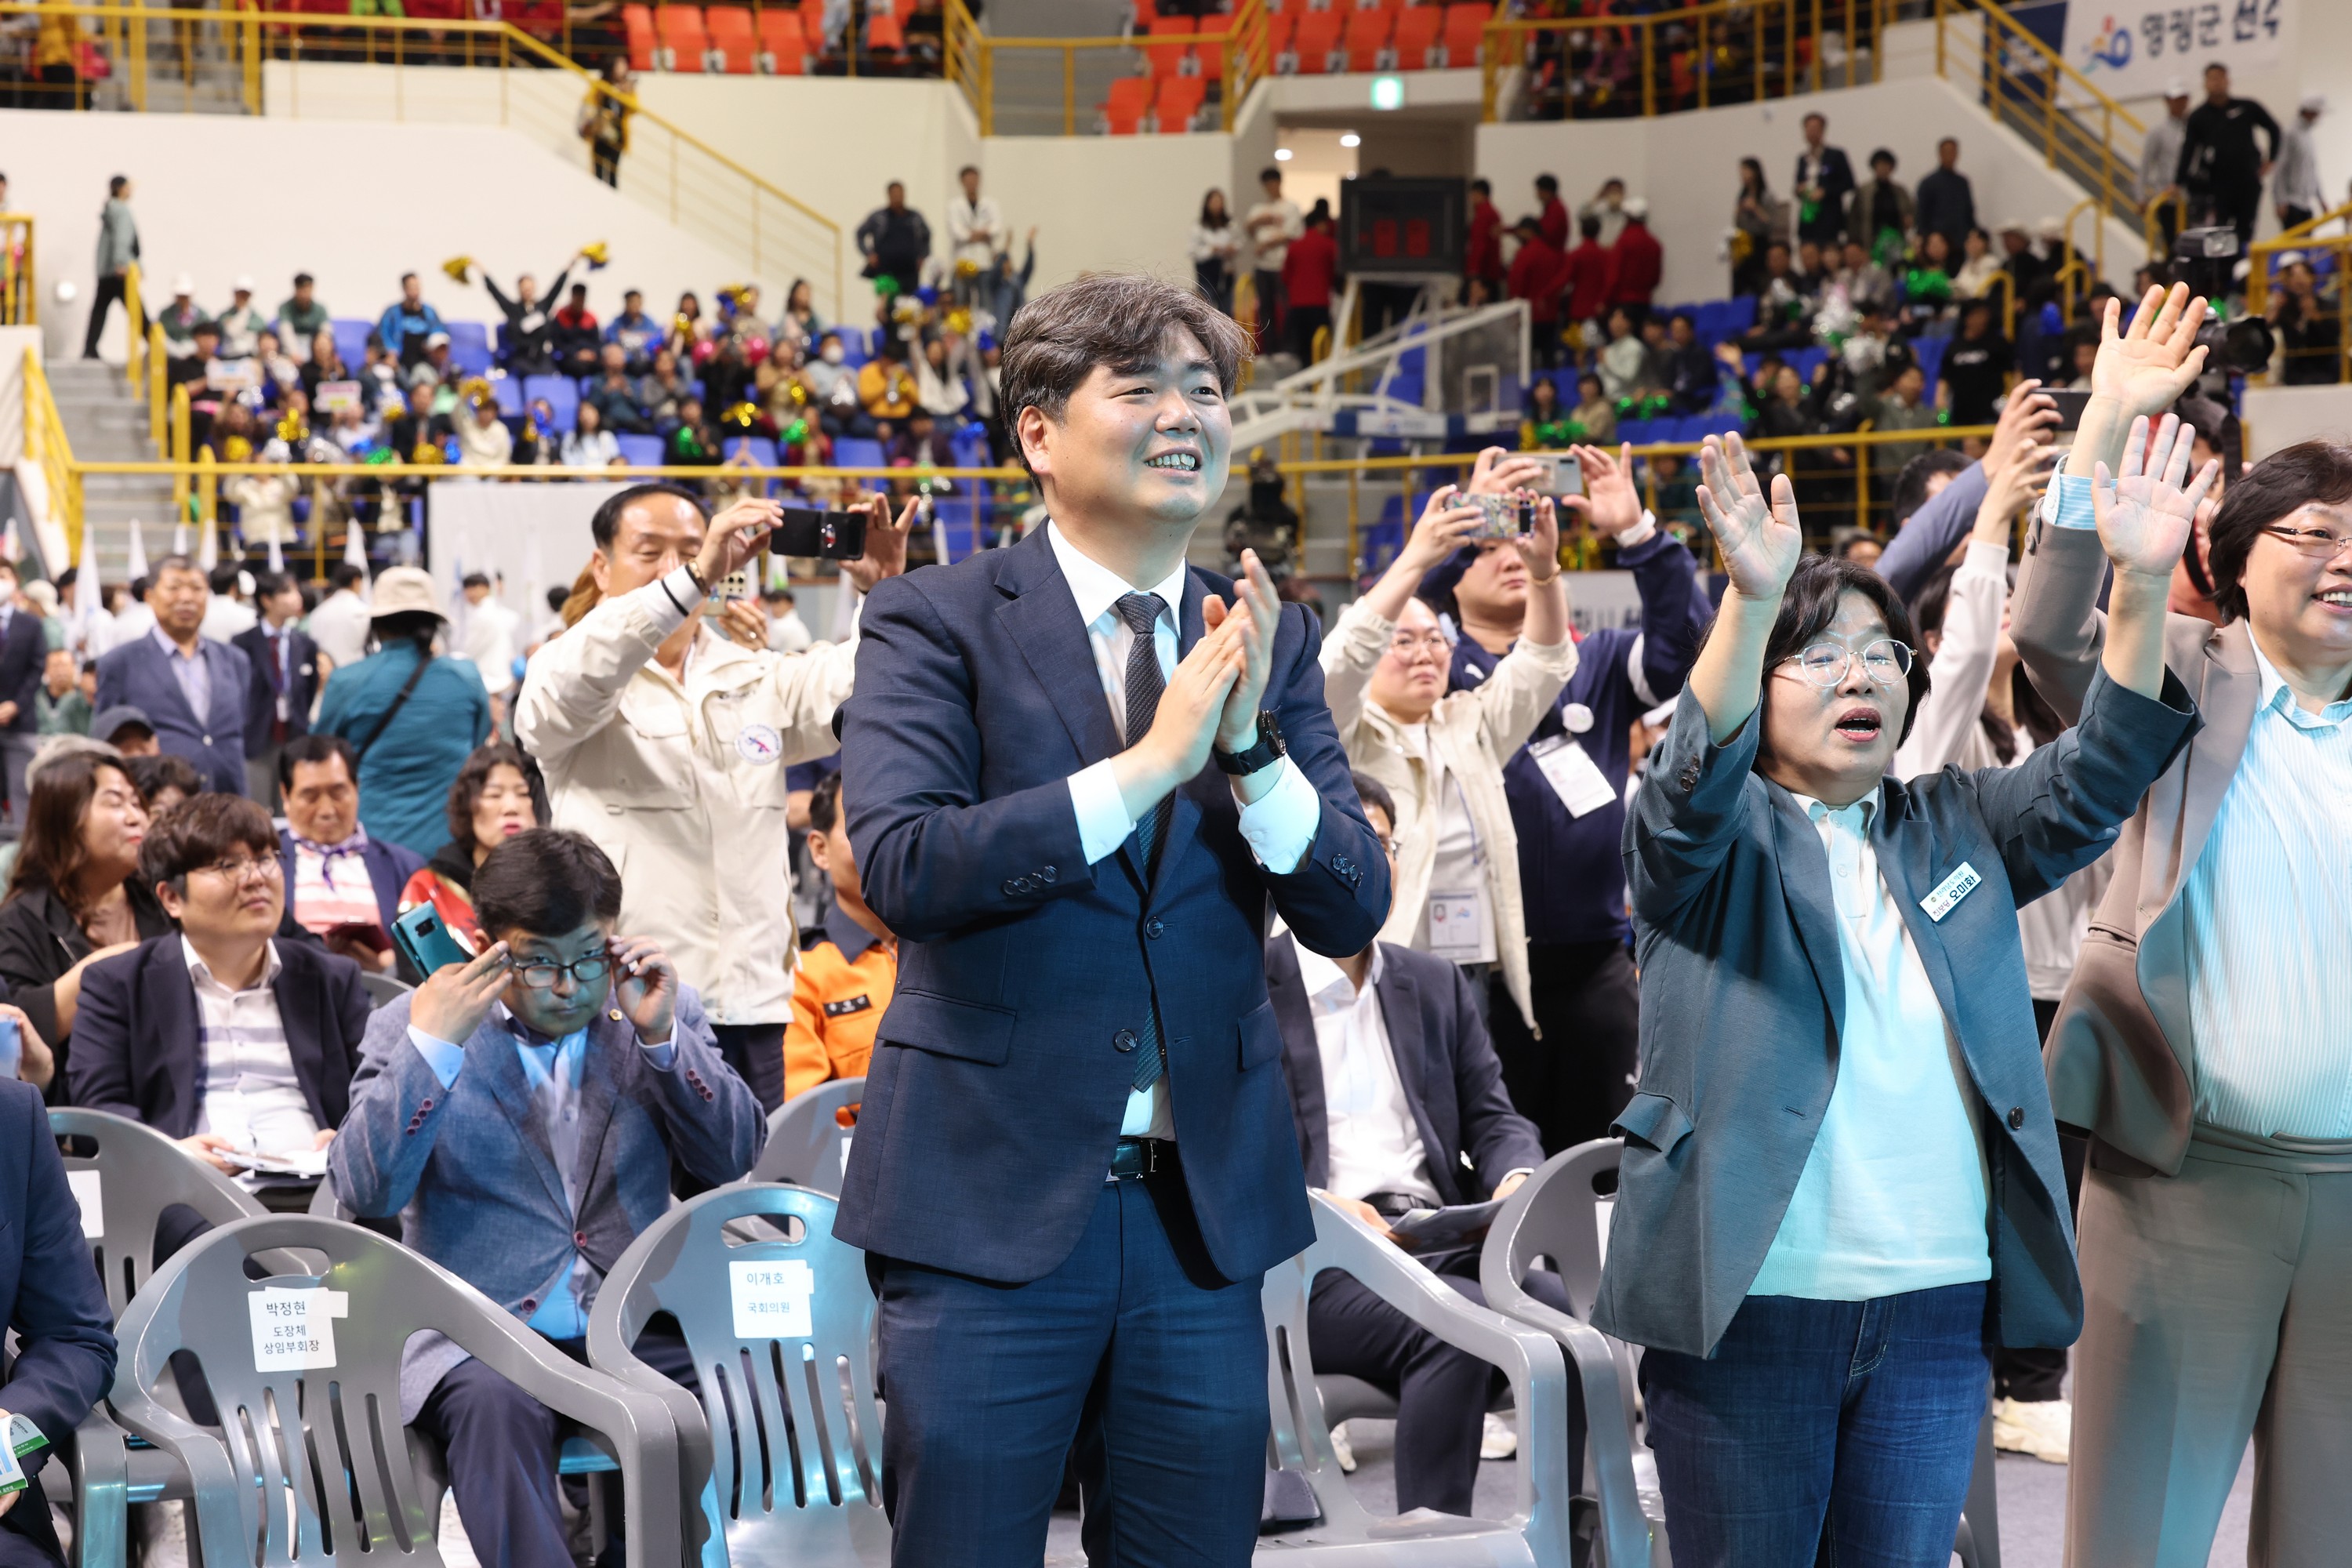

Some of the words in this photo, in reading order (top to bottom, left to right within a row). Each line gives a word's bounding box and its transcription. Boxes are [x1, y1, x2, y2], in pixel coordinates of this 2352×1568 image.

[1933, 899, 1951, 916] 진보당
[1949, 874, 1976, 902] 오미화
[746, 1272, 785, 1286] 이개호
[266, 1301, 306, 1316] 박정현
[747, 1301, 790, 1314] 국회의원
[274, 1324, 307, 1337] 도장체
[263, 1339, 320, 1355] 상임부회장
